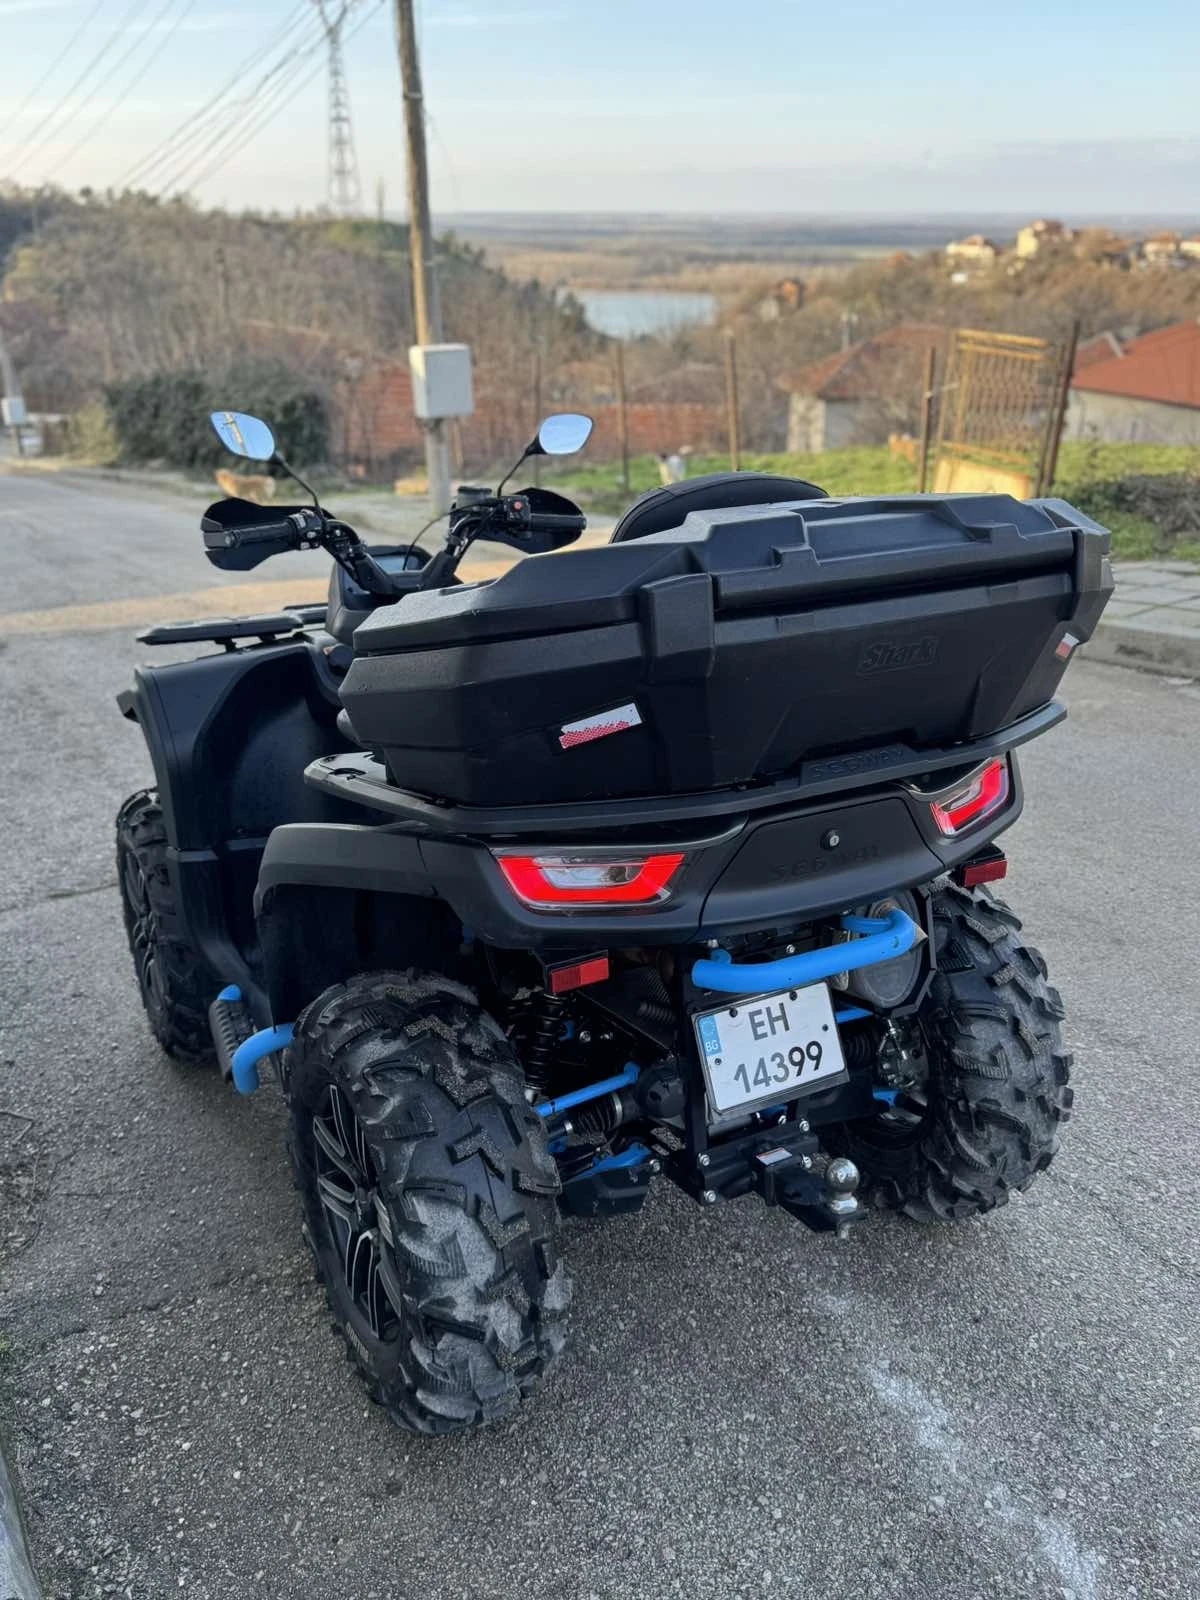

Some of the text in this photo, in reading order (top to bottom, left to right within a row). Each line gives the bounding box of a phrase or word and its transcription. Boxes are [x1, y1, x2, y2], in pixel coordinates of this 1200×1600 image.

[748, 1002, 790, 1041] EH
[705, 1039, 719, 1052] BG
[733, 1041, 823, 1093] 14399
